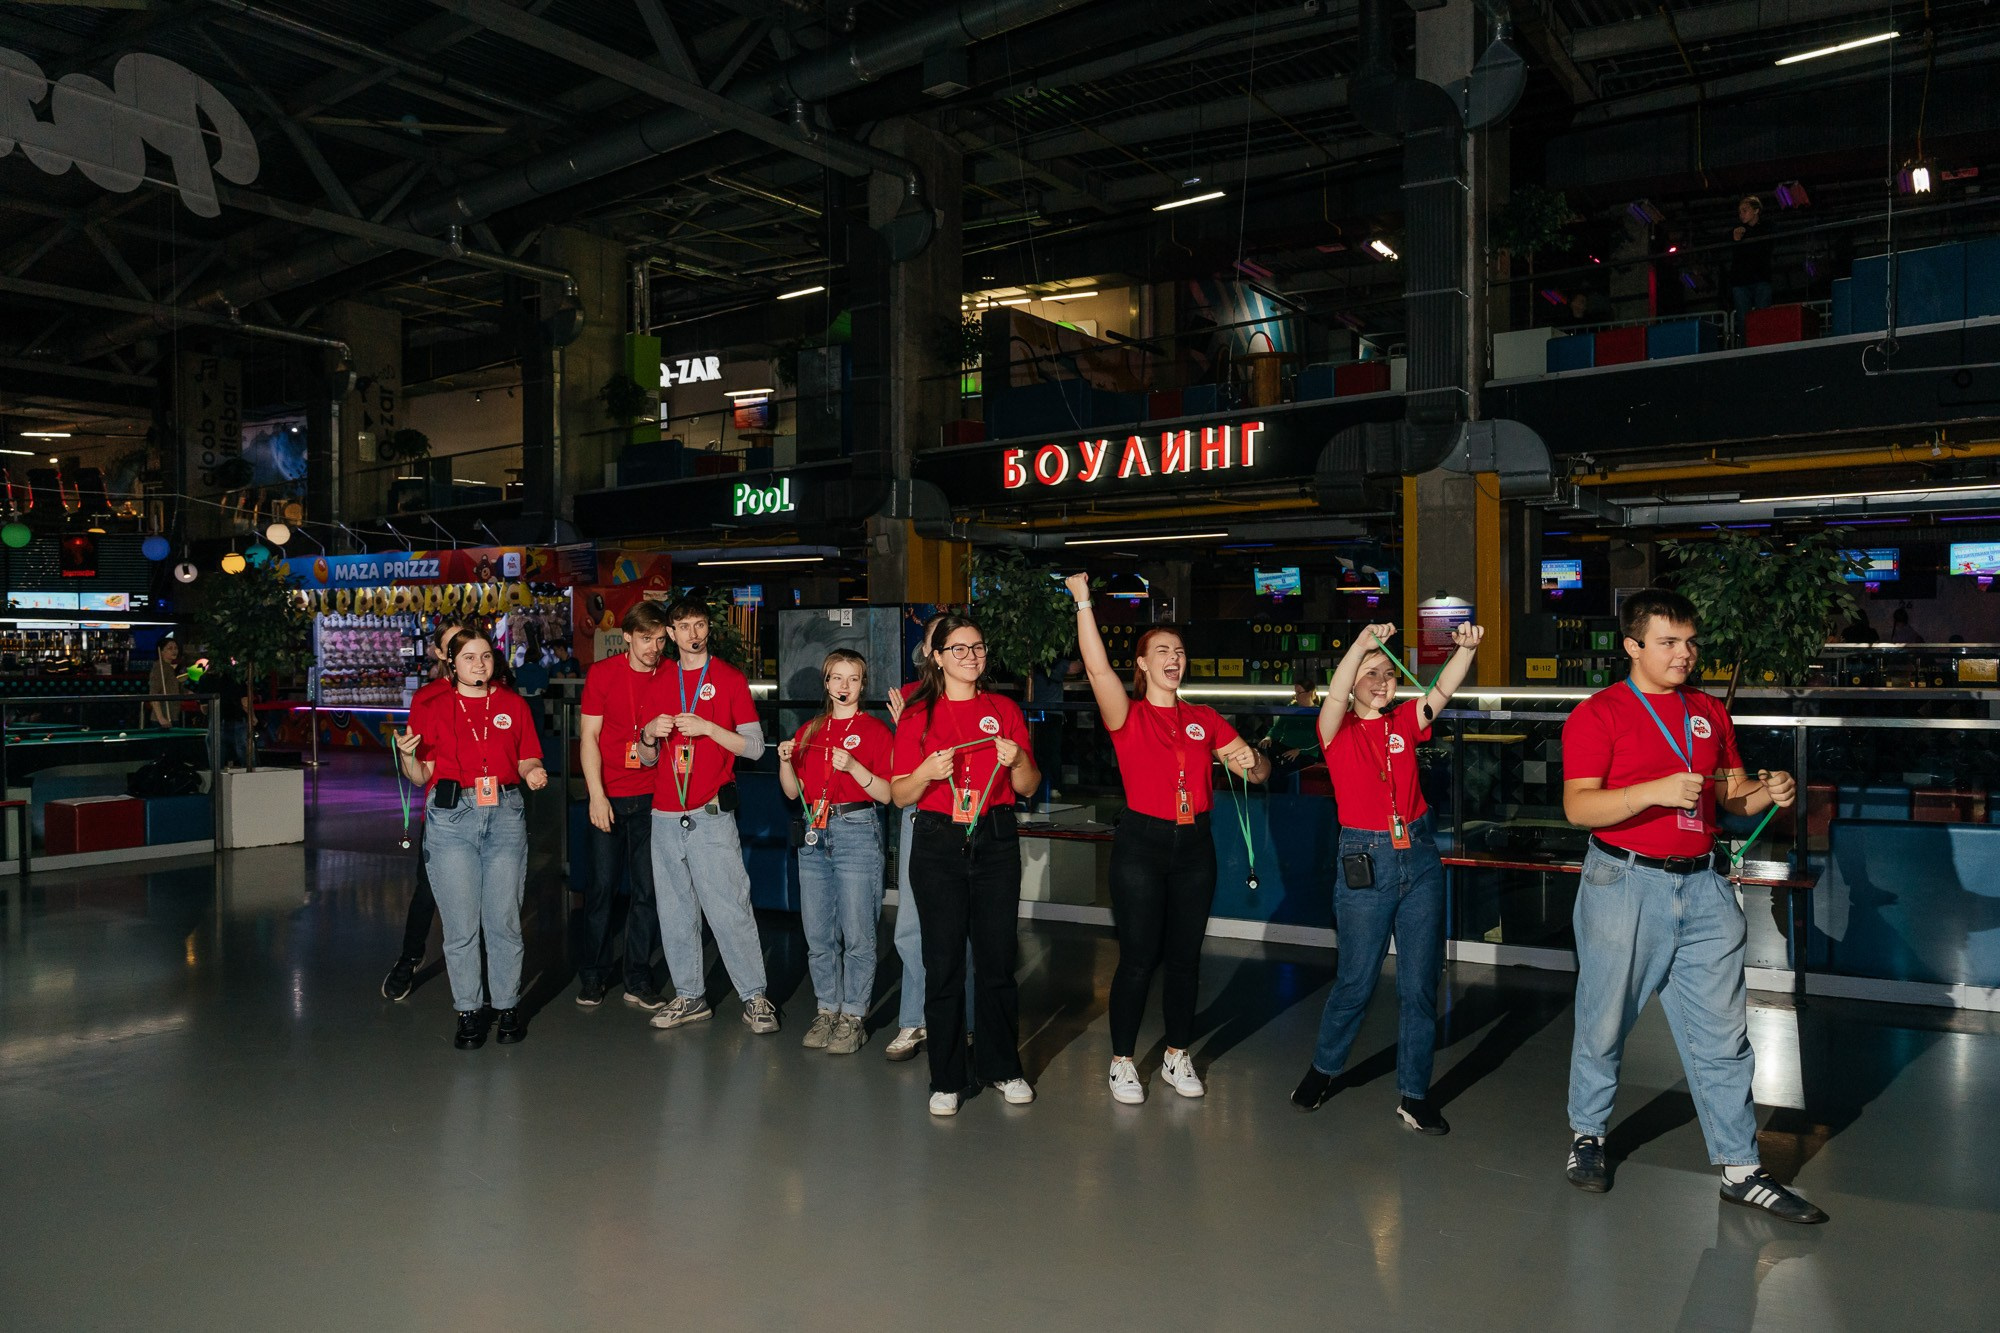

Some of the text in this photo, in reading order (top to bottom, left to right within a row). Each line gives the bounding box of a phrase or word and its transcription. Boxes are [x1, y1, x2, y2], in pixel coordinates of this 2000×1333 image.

[1003, 421, 1265, 489] БОУЛИНГ
[335, 559, 440, 581] MAZA PRIZZZ
